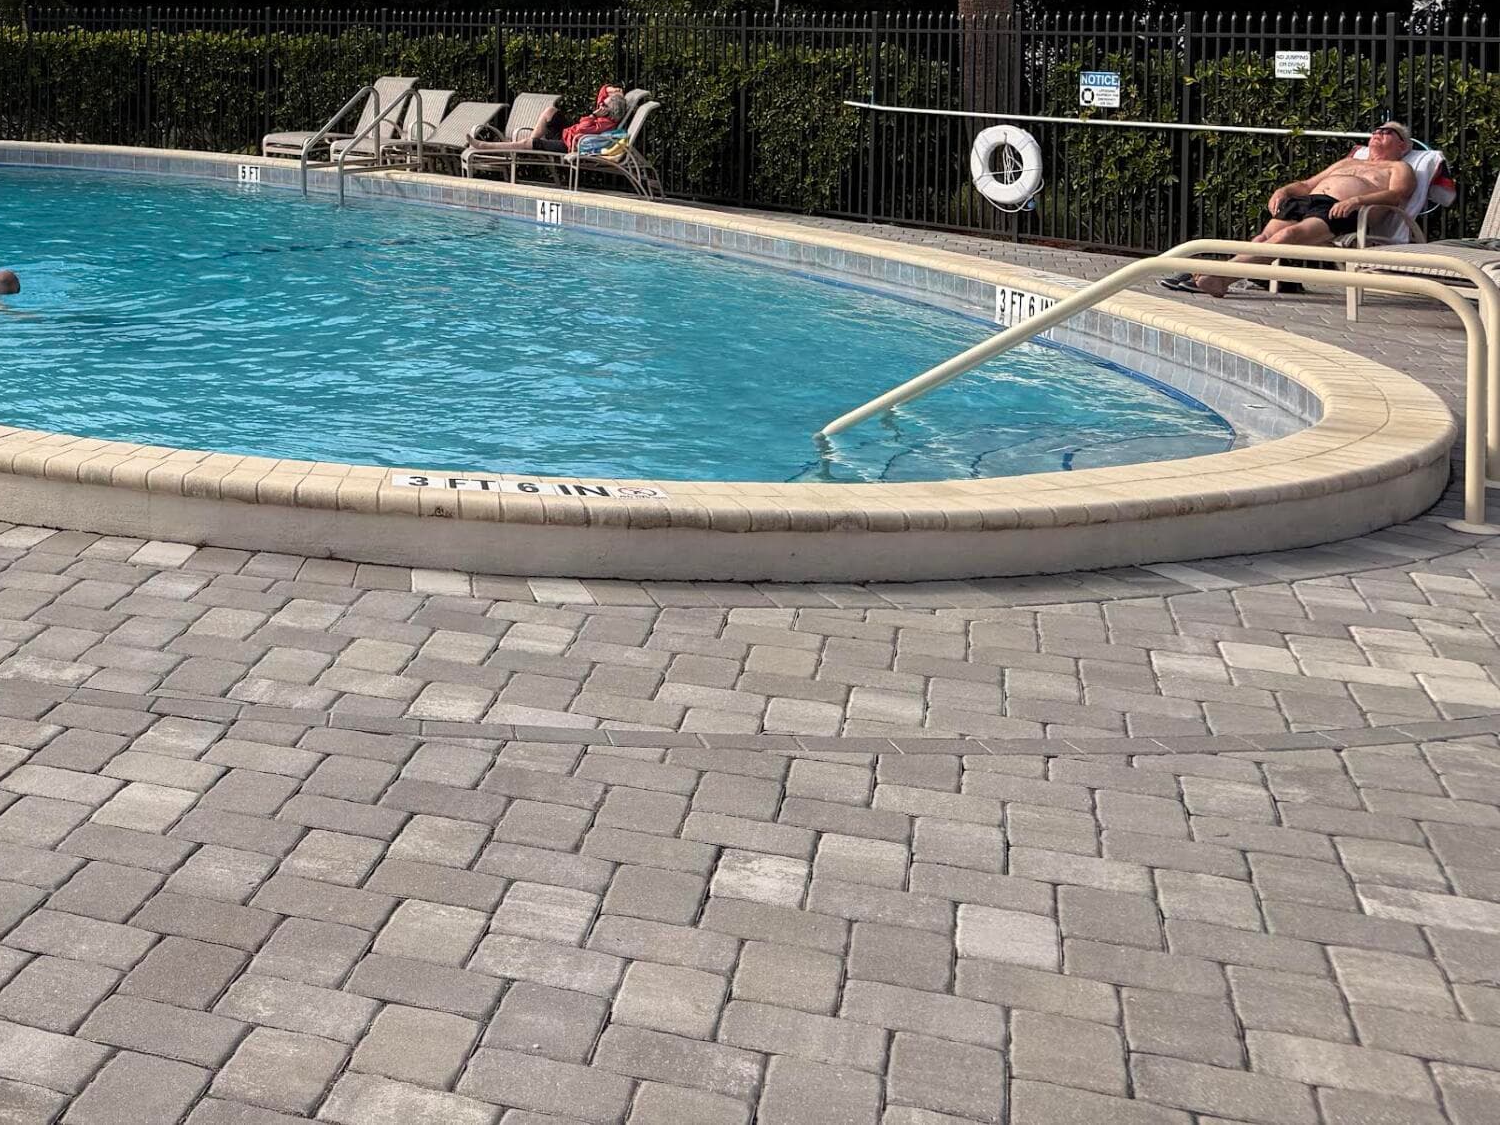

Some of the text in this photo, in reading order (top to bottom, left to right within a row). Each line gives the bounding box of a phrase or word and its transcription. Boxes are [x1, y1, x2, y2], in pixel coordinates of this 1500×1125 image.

[1081, 75, 1117, 85] NOTICE
[241, 166, 259, 180] 5 FT
[540, 201, 560, 223] 4 FT
[1000, 289, 1005, 313] 3
[1010, 290, 1025, 320] FT
[1028, 296, 1035, 317] 6
[408, 476, 611, 497] 3 FT 6 IN
